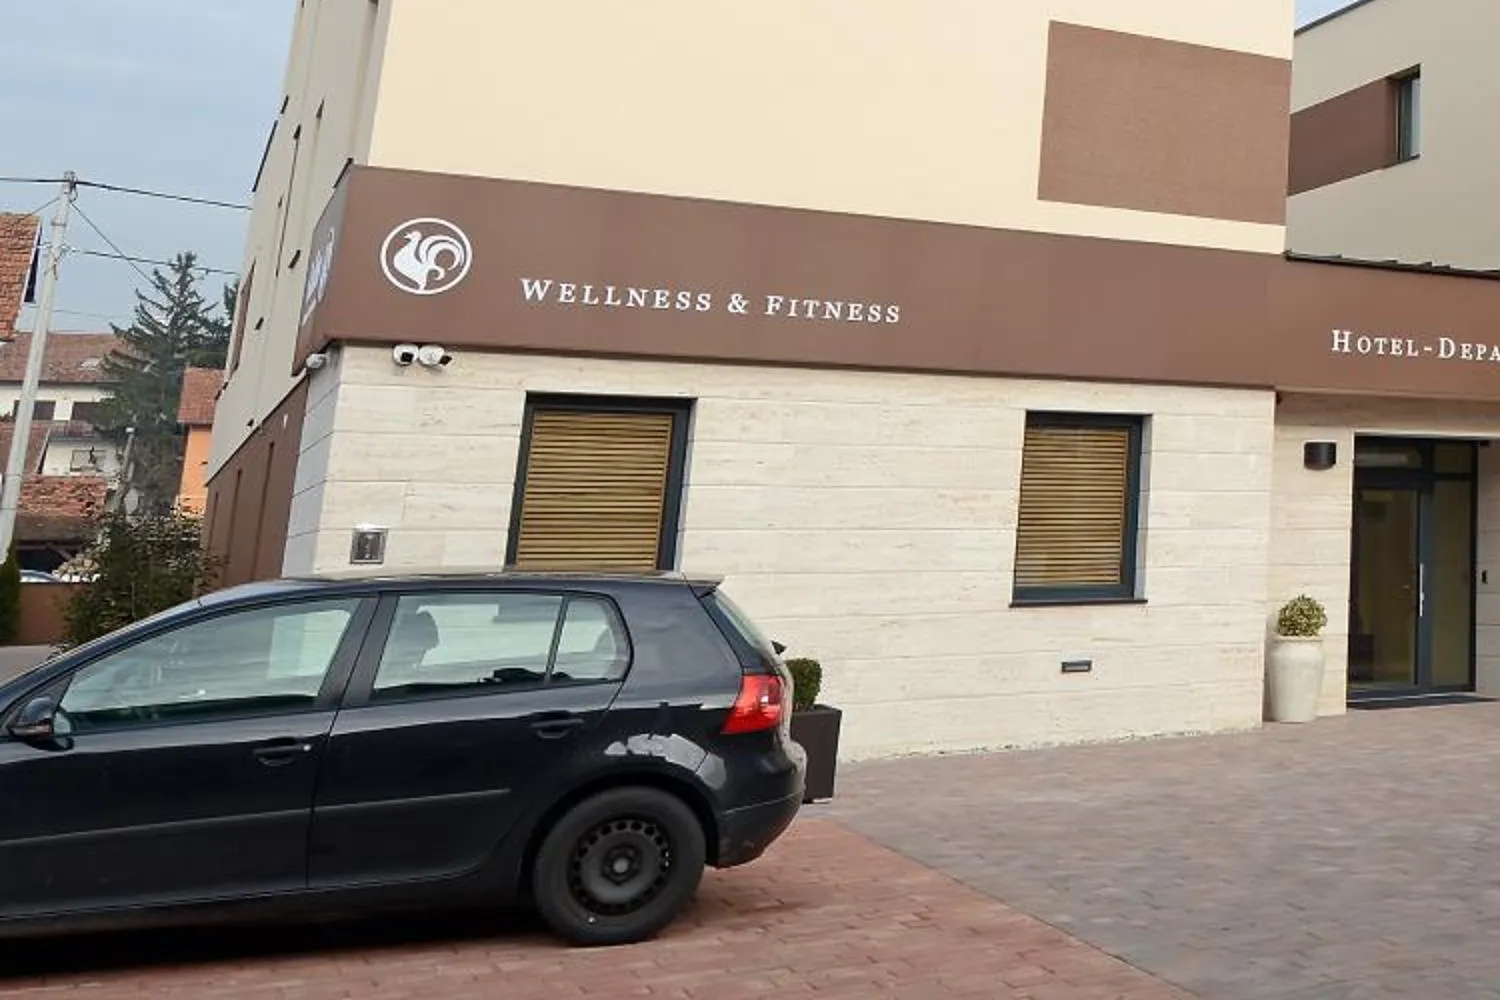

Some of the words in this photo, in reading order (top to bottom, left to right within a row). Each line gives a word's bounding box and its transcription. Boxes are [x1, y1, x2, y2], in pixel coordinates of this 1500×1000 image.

[520, 278, 712, 312] WELLNESS
[727, 293, 750, 314] &
[764, 295, 901, 323] FITNESS
